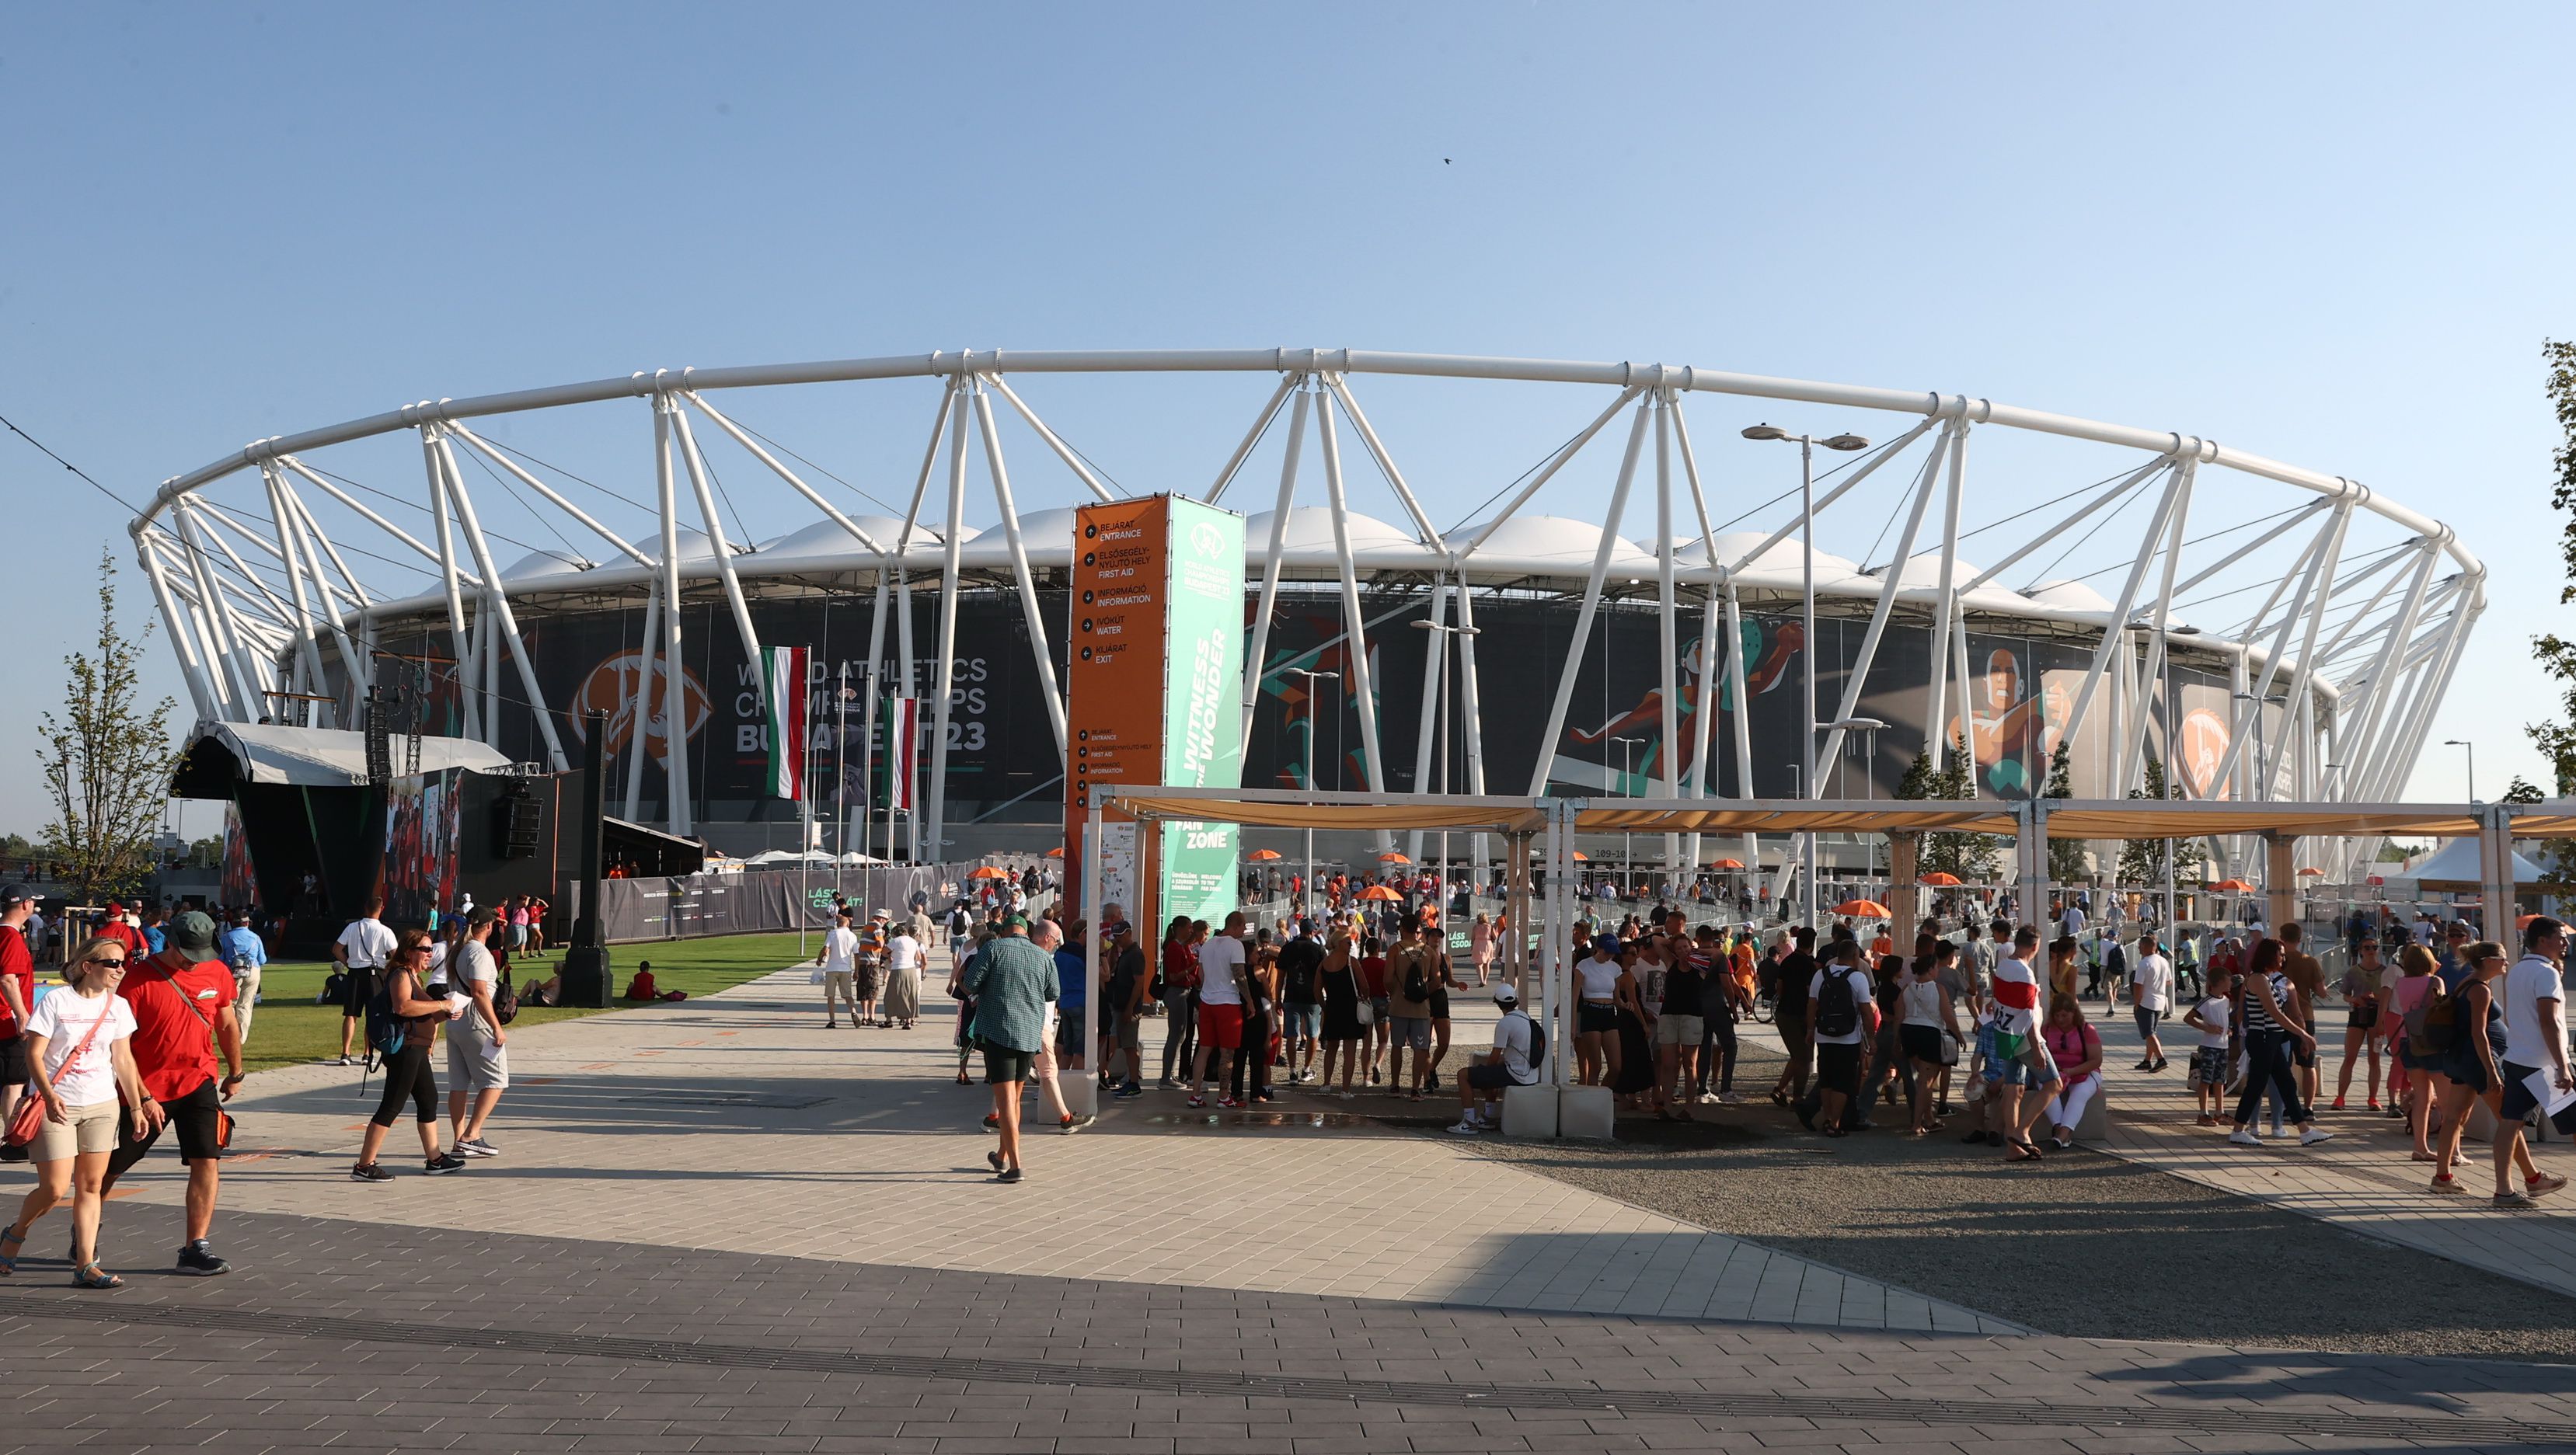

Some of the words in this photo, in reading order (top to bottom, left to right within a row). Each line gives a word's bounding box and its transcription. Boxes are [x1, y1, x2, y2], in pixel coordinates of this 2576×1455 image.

[1100, 520, 1135, 531] BEJÁRAT
[1100, 529, 1142, 541] ENTRANCE
[1131, 556, 1150, 566] HELY
[1098, 569, 1119, 579] FIRST
[1121, 568, 1135, 576] AID
[1097, 583, 1147, 597] INFORMÁCIÓ
[1097, 594, 1150, 607] INFORMATION
[1096, 614, 1125, 625] IVÓKÚT
[1096, 625, 1122, 635] WATER
[1096, 643, 1128, 654] KIJÁRAT
[1096, 654, 1113, 664] EXIT
[837, 657, 987, 682] ATHLETCS
[1199, 628, 1227, 761] WONDER
[1183, 637, 1210, 771] WITNESS
[1187, 831, 1228, 850] ZONE
[1448, 931, 1466, 940] LÁSS
